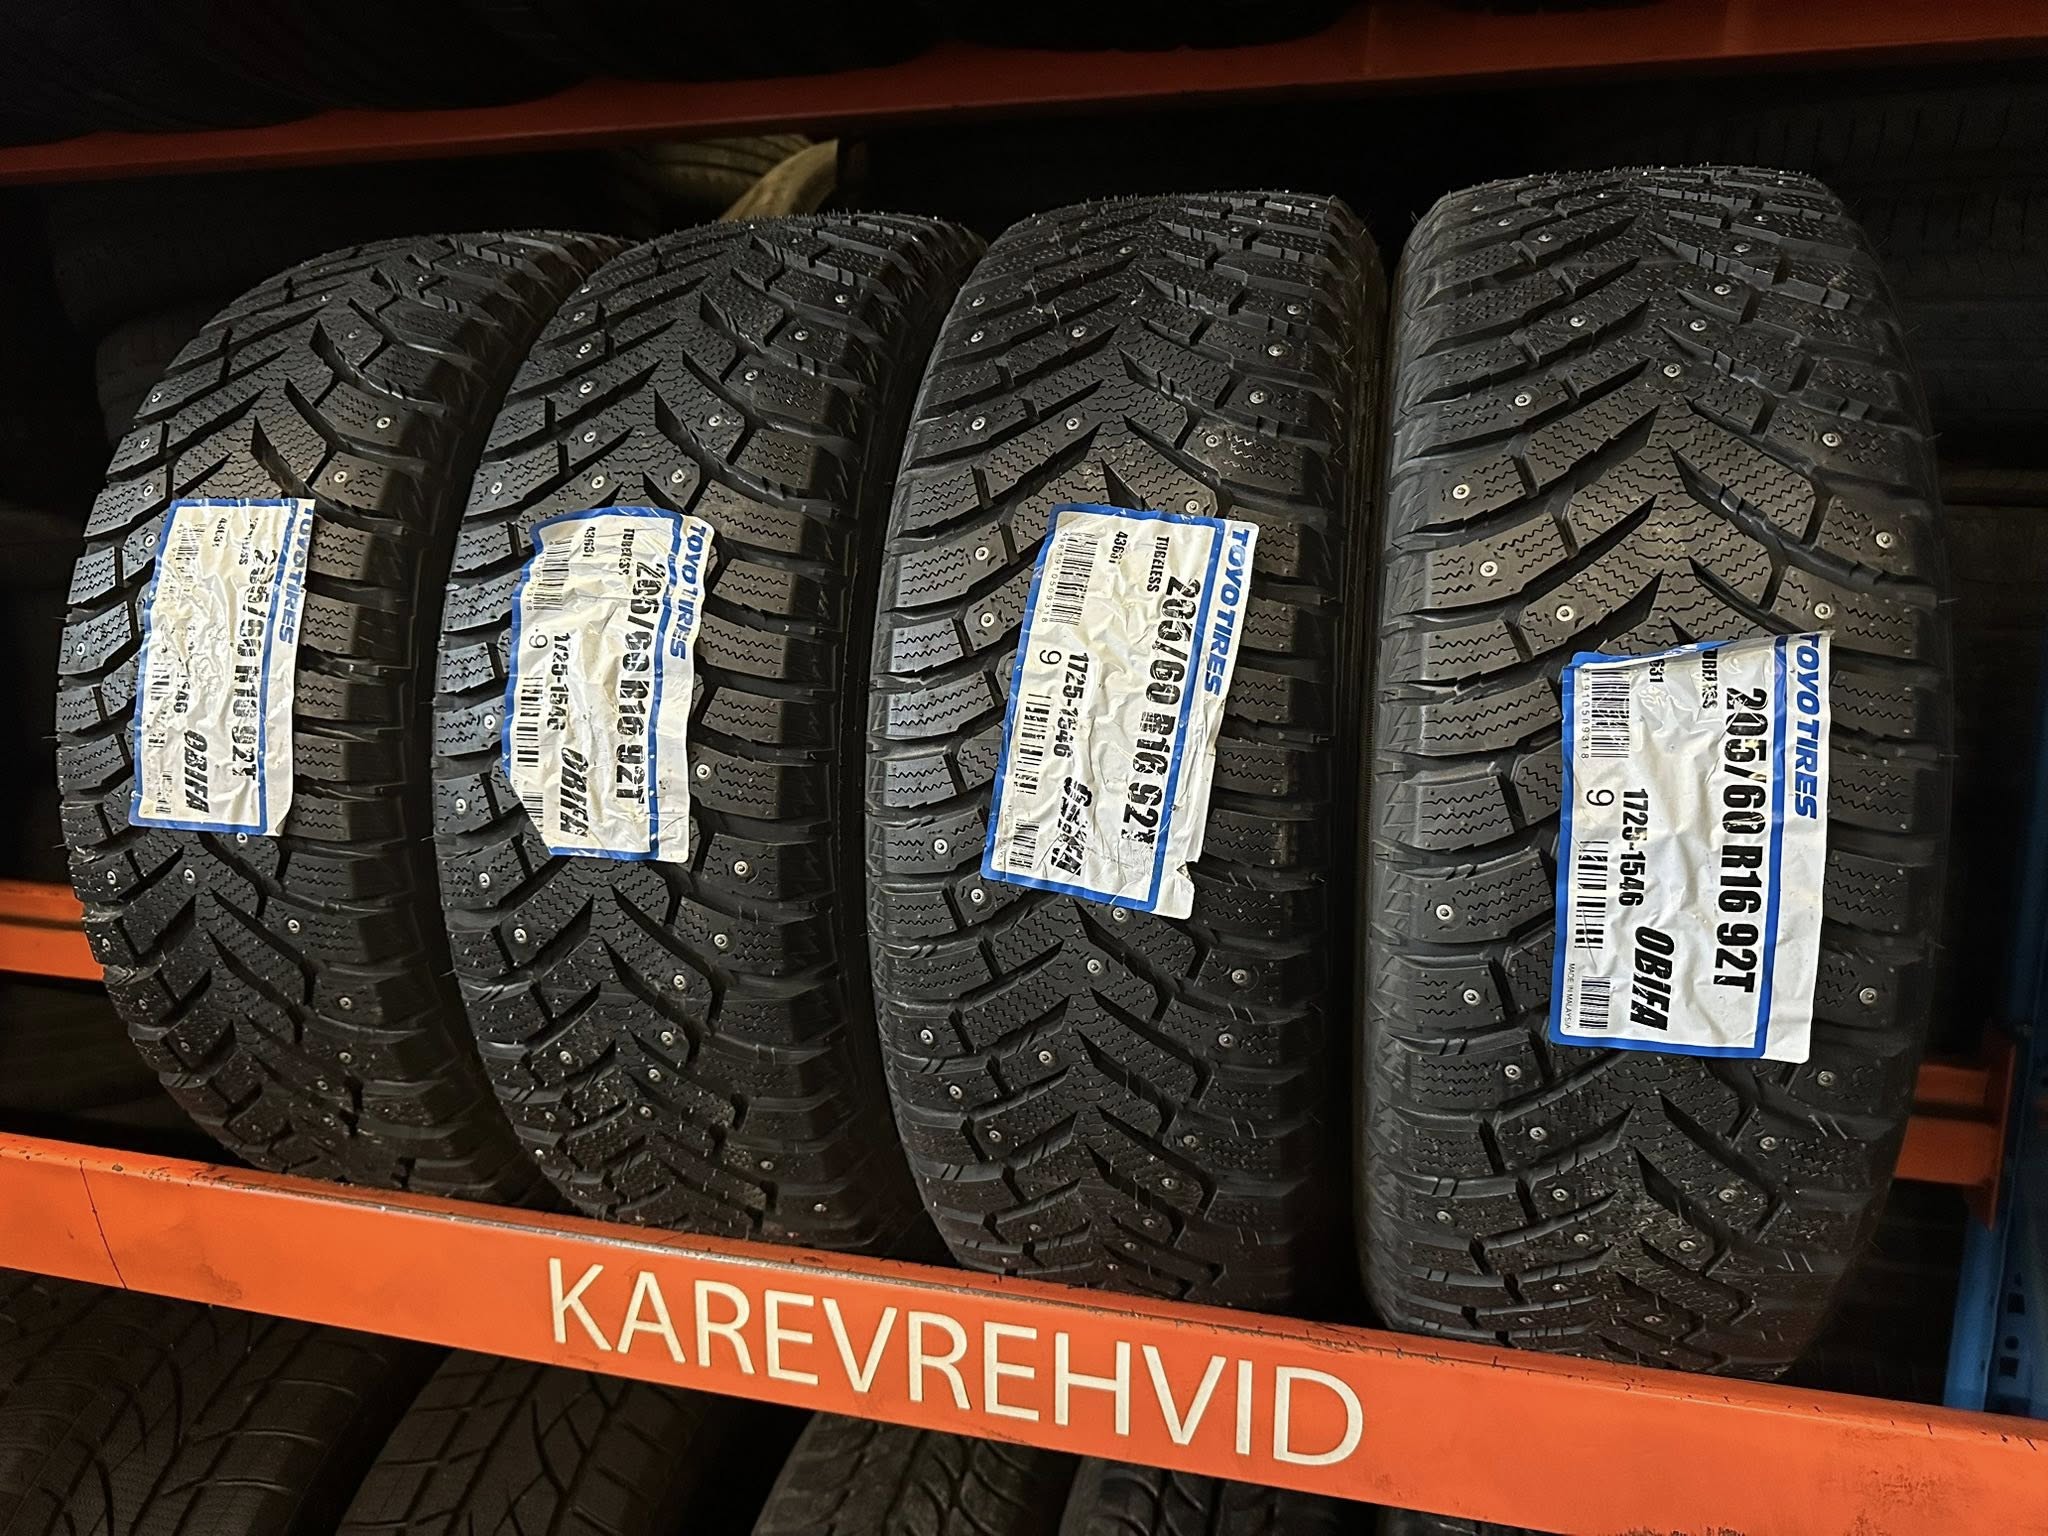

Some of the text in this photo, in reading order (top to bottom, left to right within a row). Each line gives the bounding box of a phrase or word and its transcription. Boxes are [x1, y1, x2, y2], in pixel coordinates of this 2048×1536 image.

[1145, 536, 1170, 593] TUBELESS
[1039, 649, 1062, 665] 9
[1145, 575, 1202, 706] 205/60
[617, 680, 650, 737] R16
[615, 744, 646, 805] 92T
[1132, 711, 1175, 776] R16
[1587, 788, 1614, 807] 9
[1619, 788, 1649, 906] 1725-1546
[1713, 687, 1769, 993] 205/60 R16 92T
[1564, 962, 1576, 1029] MADE IN MALAYSIA
[1630, 926, 1675, 1031] OBIFA
[547, 1257, 1364, 1466] KAREVREHVID
